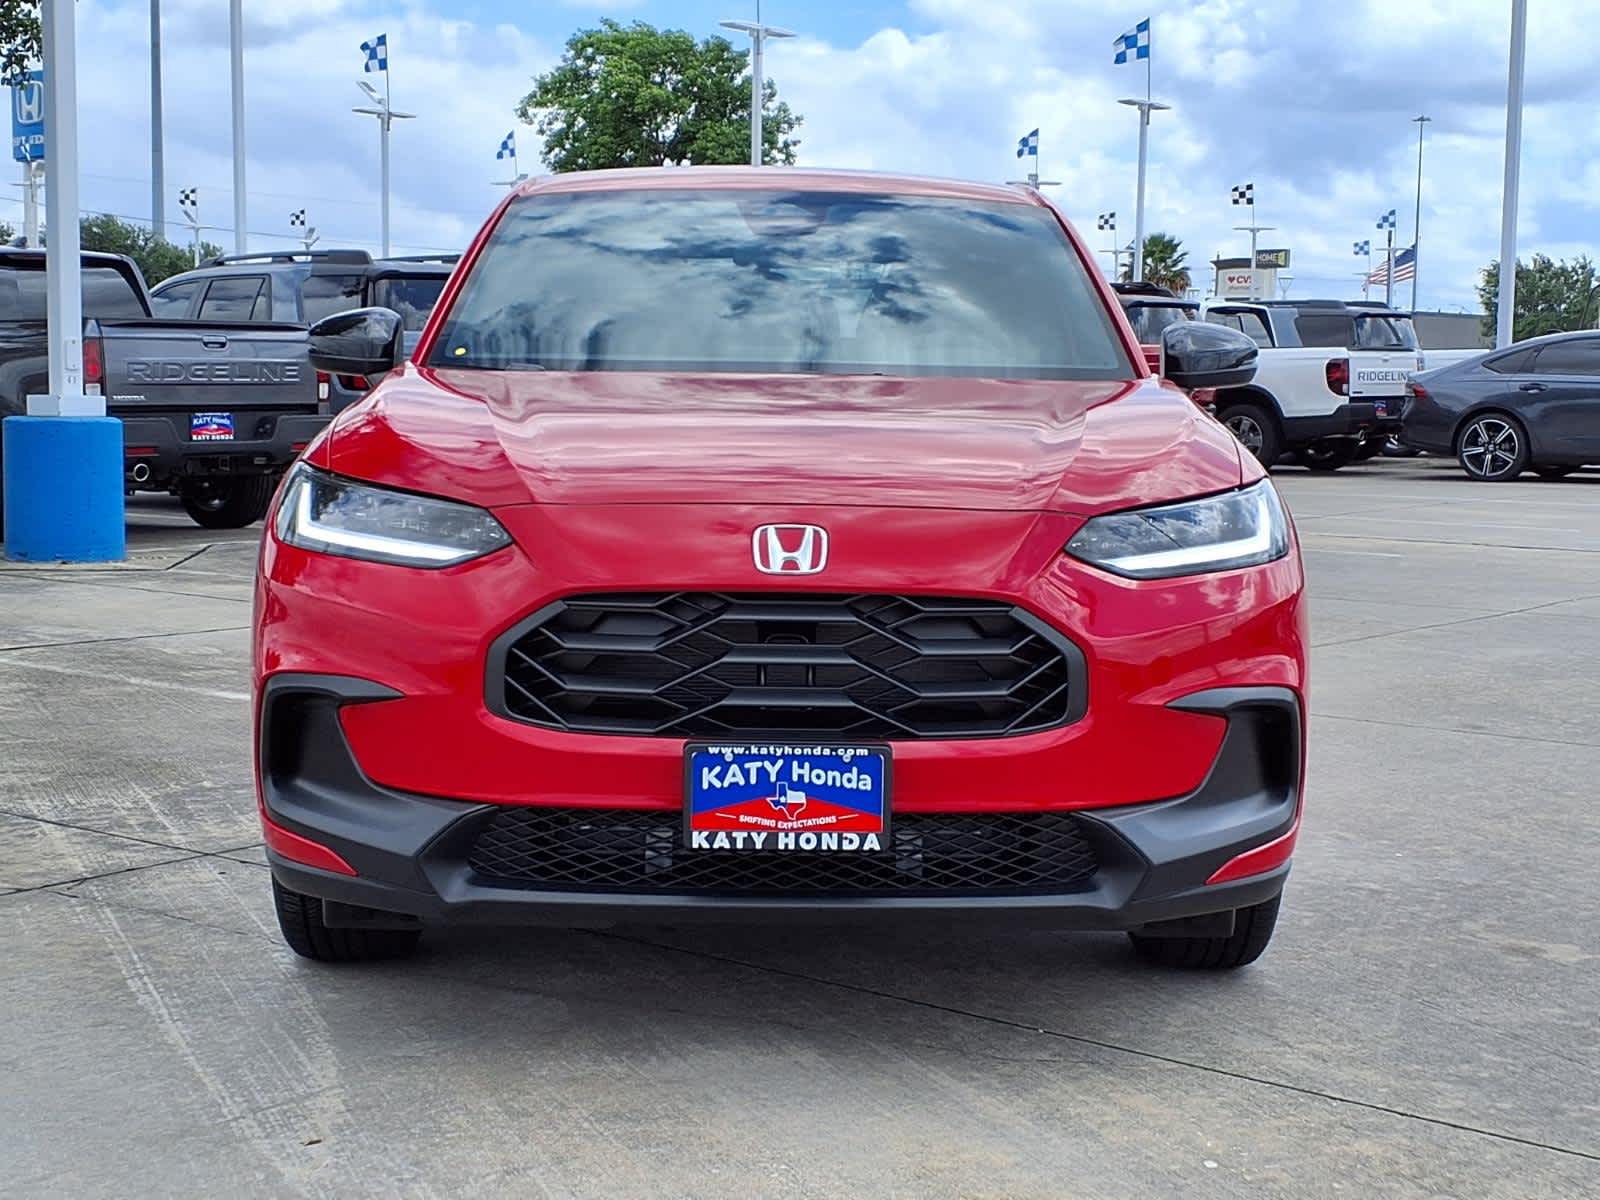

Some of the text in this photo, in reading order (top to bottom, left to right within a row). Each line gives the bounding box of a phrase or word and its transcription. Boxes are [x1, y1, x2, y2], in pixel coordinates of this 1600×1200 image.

[127, 361, 300, 382] RIDGELINE
[1358, 370, 1409, 382] RIDGELIN
[707, 745, 870, 757] www.katyhonda.com
[702, 759, 872, 791] KATY Honda
[738, 814, 837, 830] SHIFTING EXPECTATIONS
[691, 831, 882, 851] KATY HONDA
